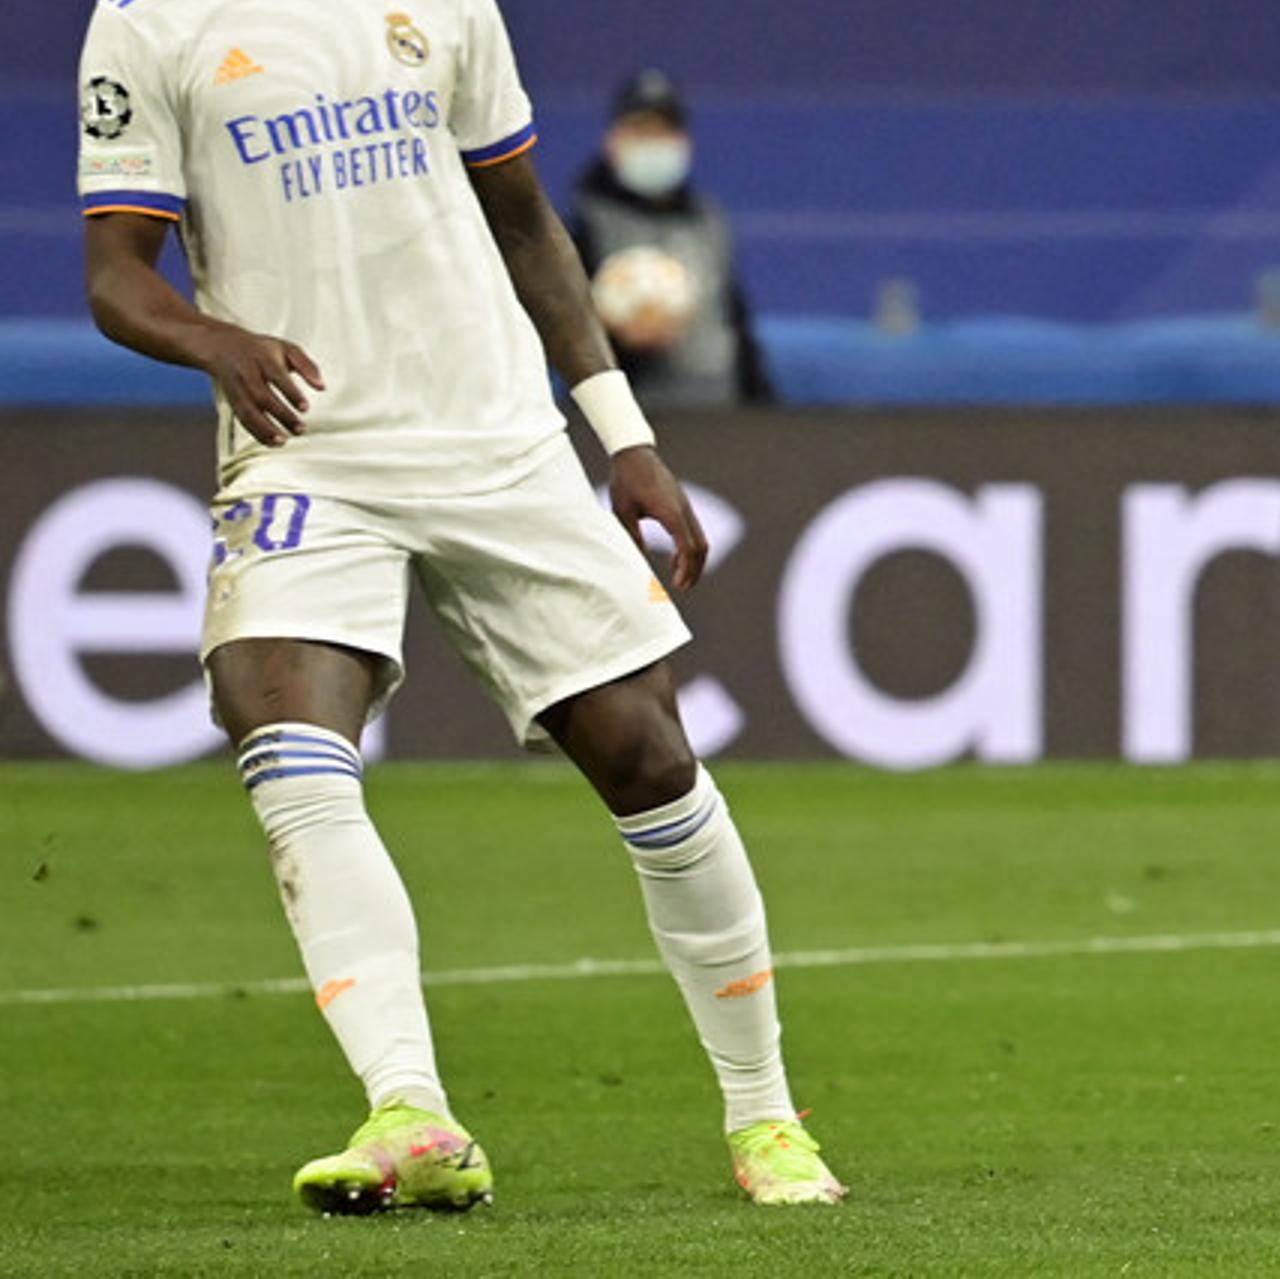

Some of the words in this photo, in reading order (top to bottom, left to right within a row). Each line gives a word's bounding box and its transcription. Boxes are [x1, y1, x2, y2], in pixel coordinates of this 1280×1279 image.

[224, 87, 439, 165] Emirates
[280, 153, 323, 203] FLY
[332, 137, 430, 190] BETTER
